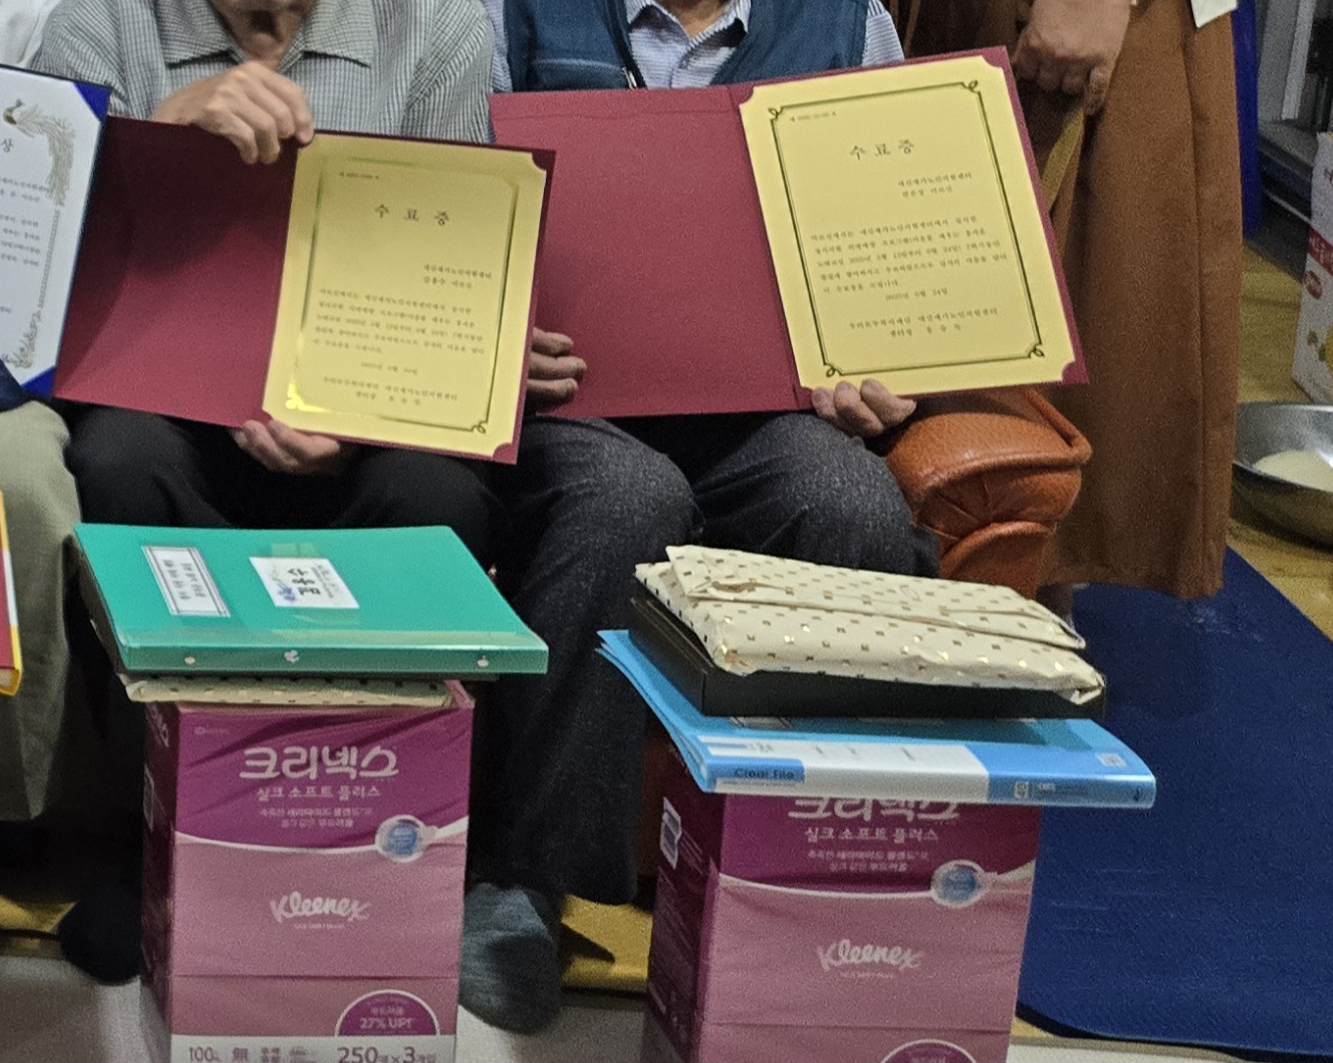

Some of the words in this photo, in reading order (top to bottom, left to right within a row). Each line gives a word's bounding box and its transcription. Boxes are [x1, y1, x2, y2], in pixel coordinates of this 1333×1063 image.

[238, 745, 400, 781] 크리넥스
[256, 786, 284, 802] 실크
[288, 786, 334, 799] 소프트
[337, 786, 381, 801] 플러스
[269, 891, 372, 925] Kleenex
[817, 938, 923, 971] Kleenex
